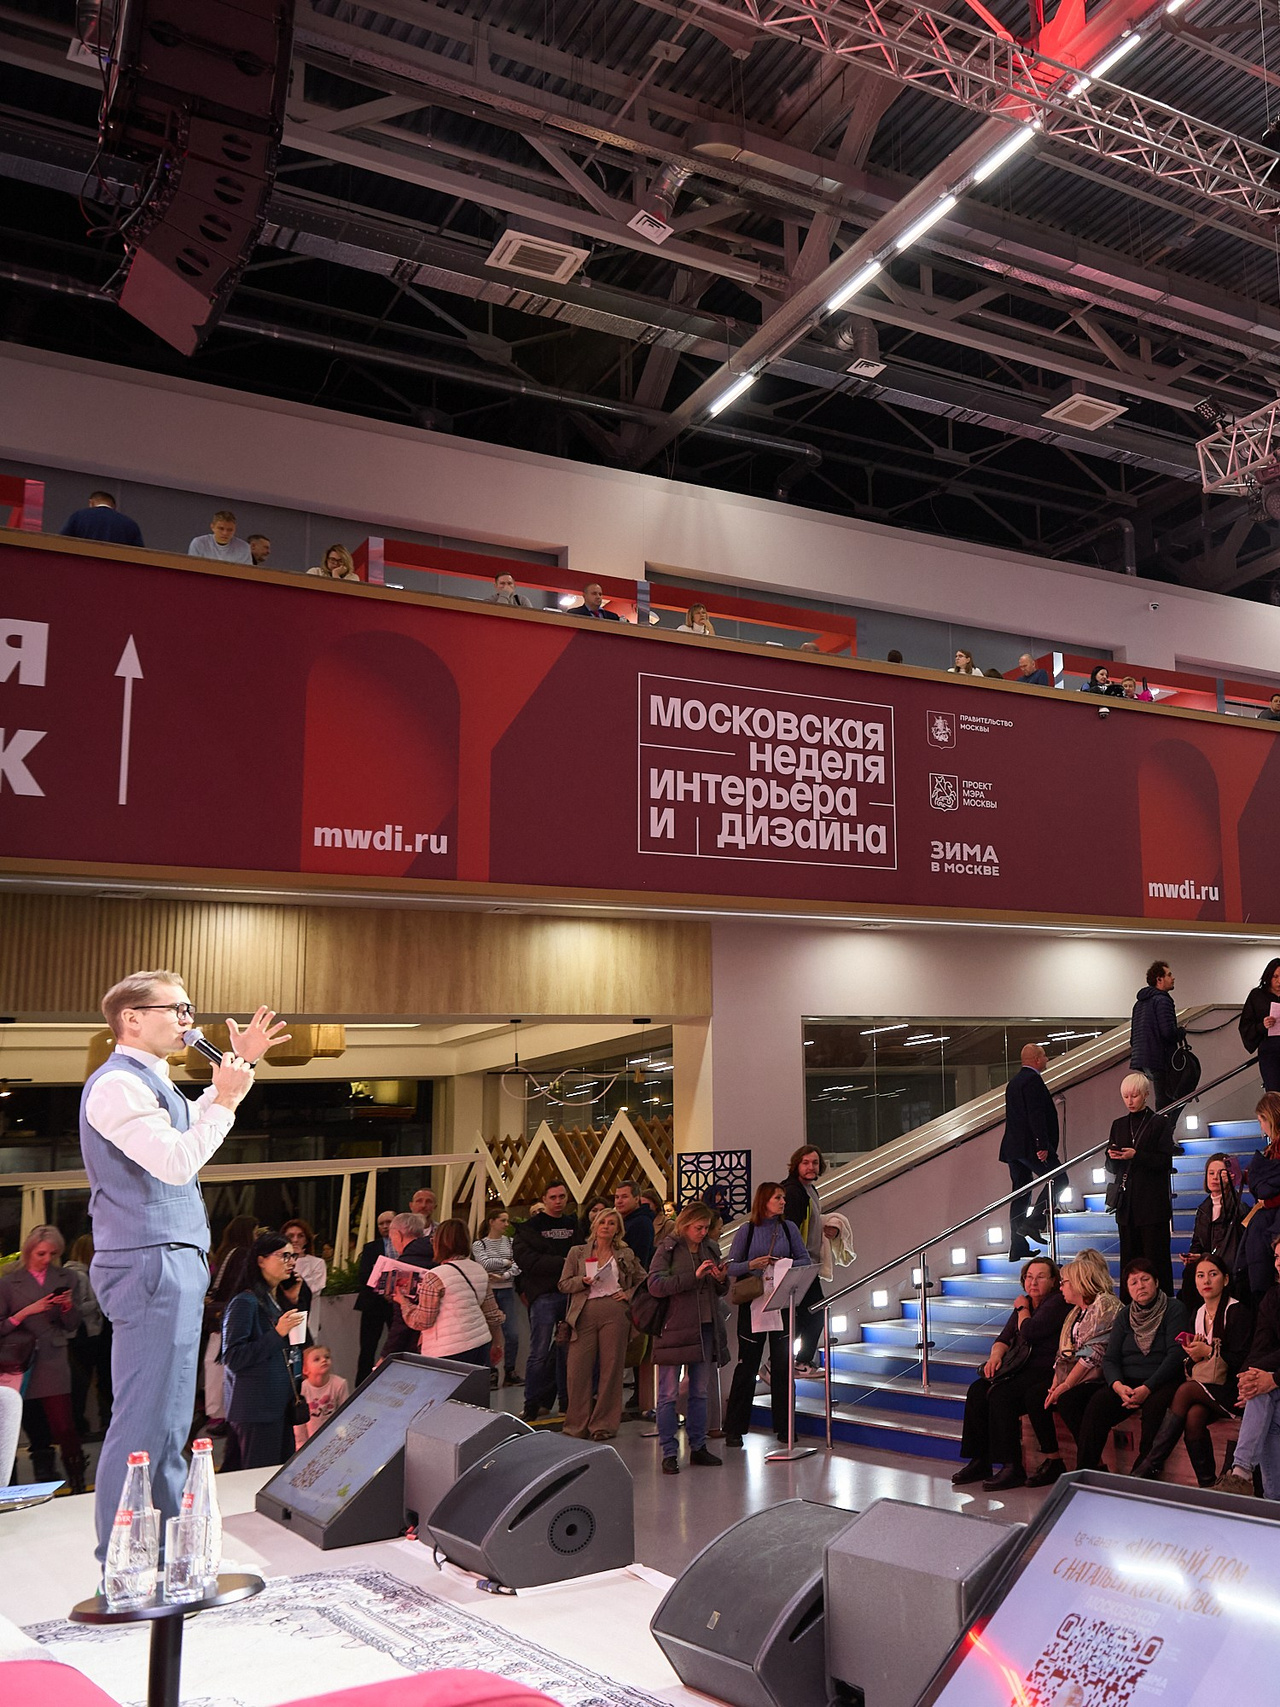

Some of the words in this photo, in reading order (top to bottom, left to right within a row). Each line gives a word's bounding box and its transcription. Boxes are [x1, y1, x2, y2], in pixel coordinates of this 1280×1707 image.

[960, 714, 1014, 728] ПРАВИТЕЛЬСТВО
[960, 723, 990, 733] МОСКВЫ
[962, 780, 993, 791] ПРОЕКТ
[962, 789, 985, 799] МЭРА
[962, 798, 998, 809] МОСКВЫ
[313, 824, 449, 855] mwdi.ru
[930, 840, 1000, 864] ЗИМА
[931, 861, 941, 873] В
[944, 862, 1000, 877] МОСКВЕ
[1148, 879, 1220, 901] mwdi.ru
